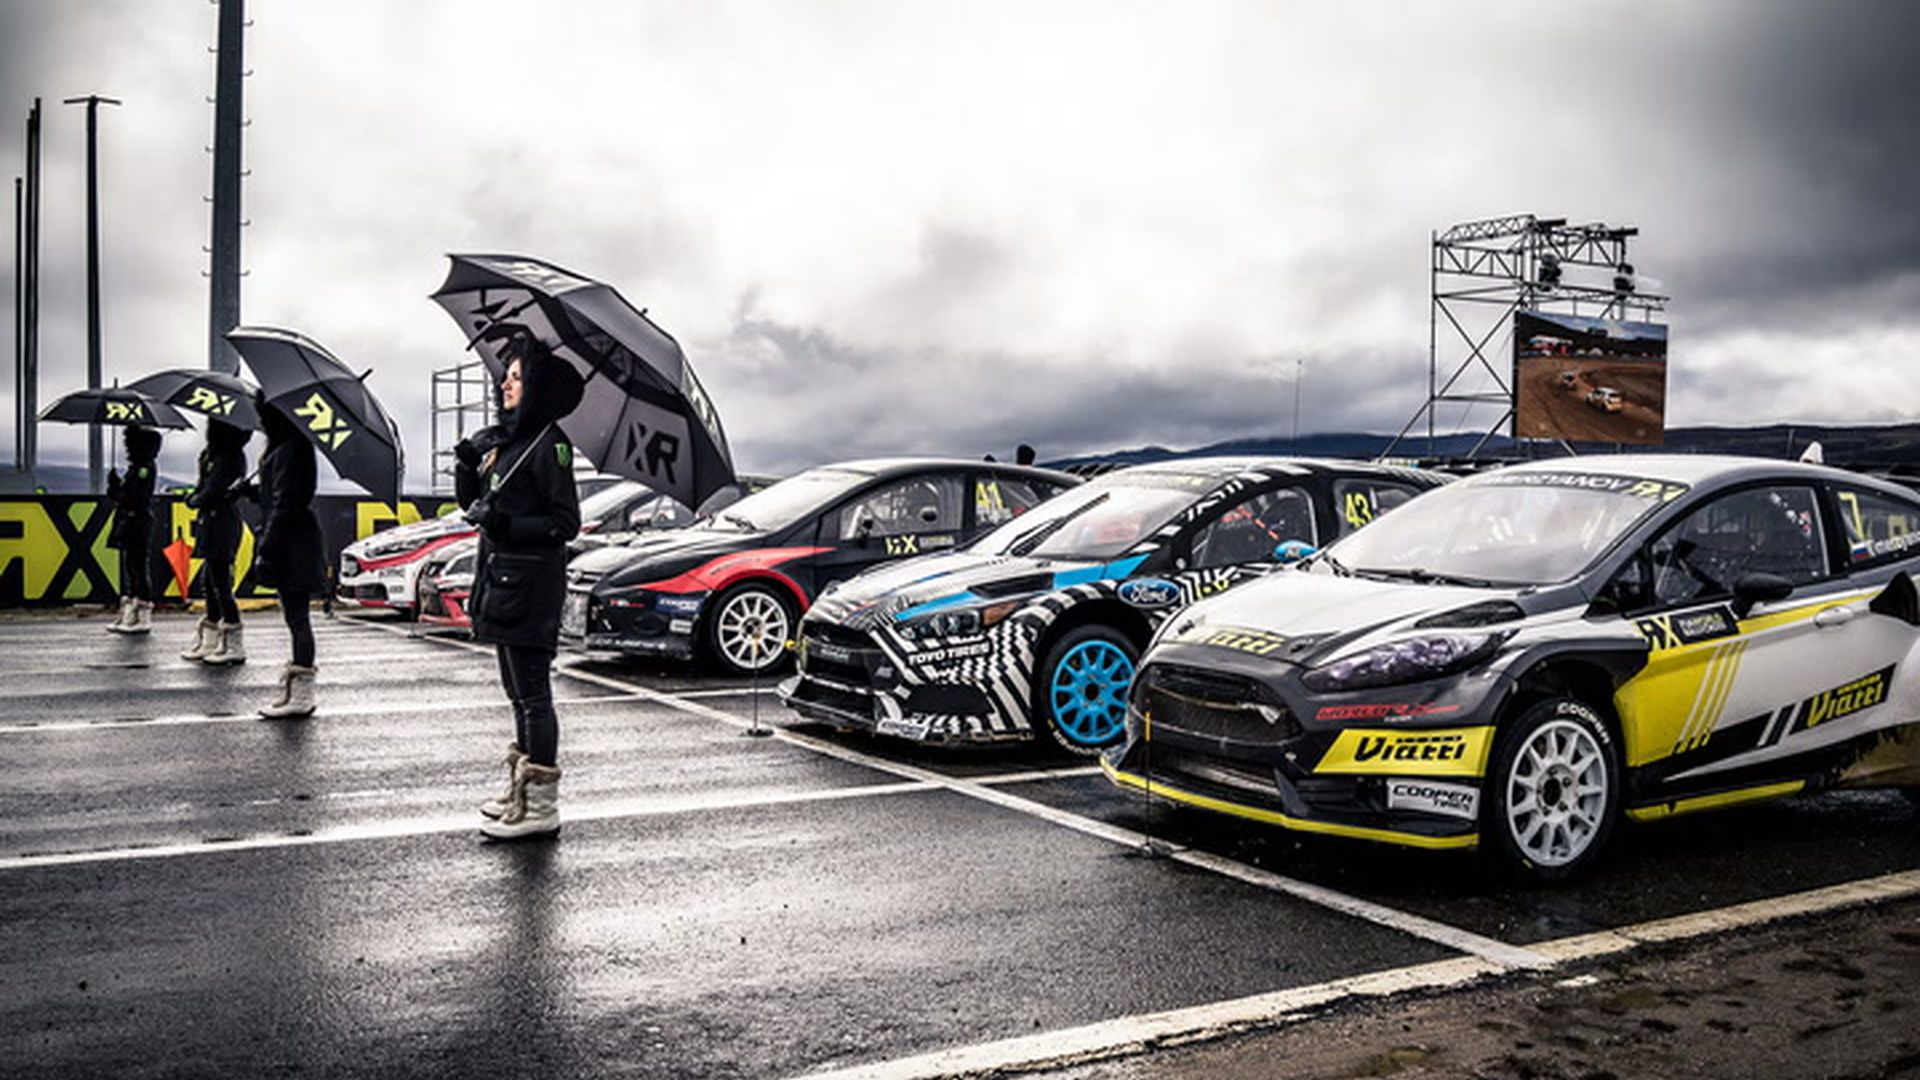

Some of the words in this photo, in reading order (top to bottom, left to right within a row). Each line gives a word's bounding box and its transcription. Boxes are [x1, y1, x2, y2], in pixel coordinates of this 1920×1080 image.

[1345, 493, 1372, 528] 43
[1129, 584, 1169, 603] Ford
[908, 649, 946, 665] TOYO
[1806, 672, 1885, 727] Viatti
[1354, 735, 1467, 762] Viatti
[1393, 784, 1474, 804] COOPER
